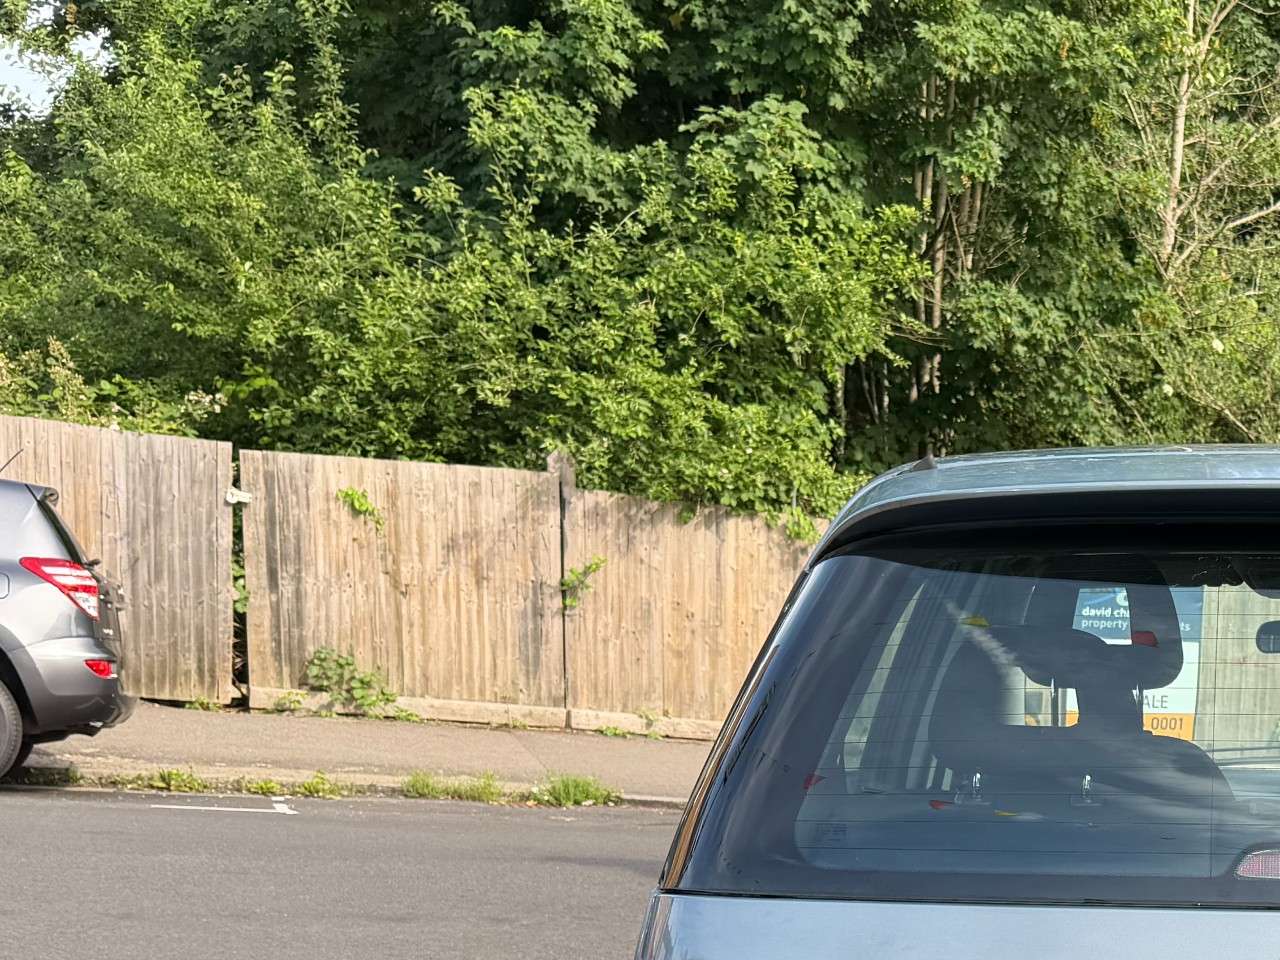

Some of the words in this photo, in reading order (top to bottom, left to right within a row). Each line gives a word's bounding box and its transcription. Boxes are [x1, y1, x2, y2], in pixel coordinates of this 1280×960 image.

[1081, 606, 1112, 618] david
[1081, 619, 1129, 631] property
[1142, 694, 1169, 709] ALE
[1151, 716, 1184, 731] 0001
